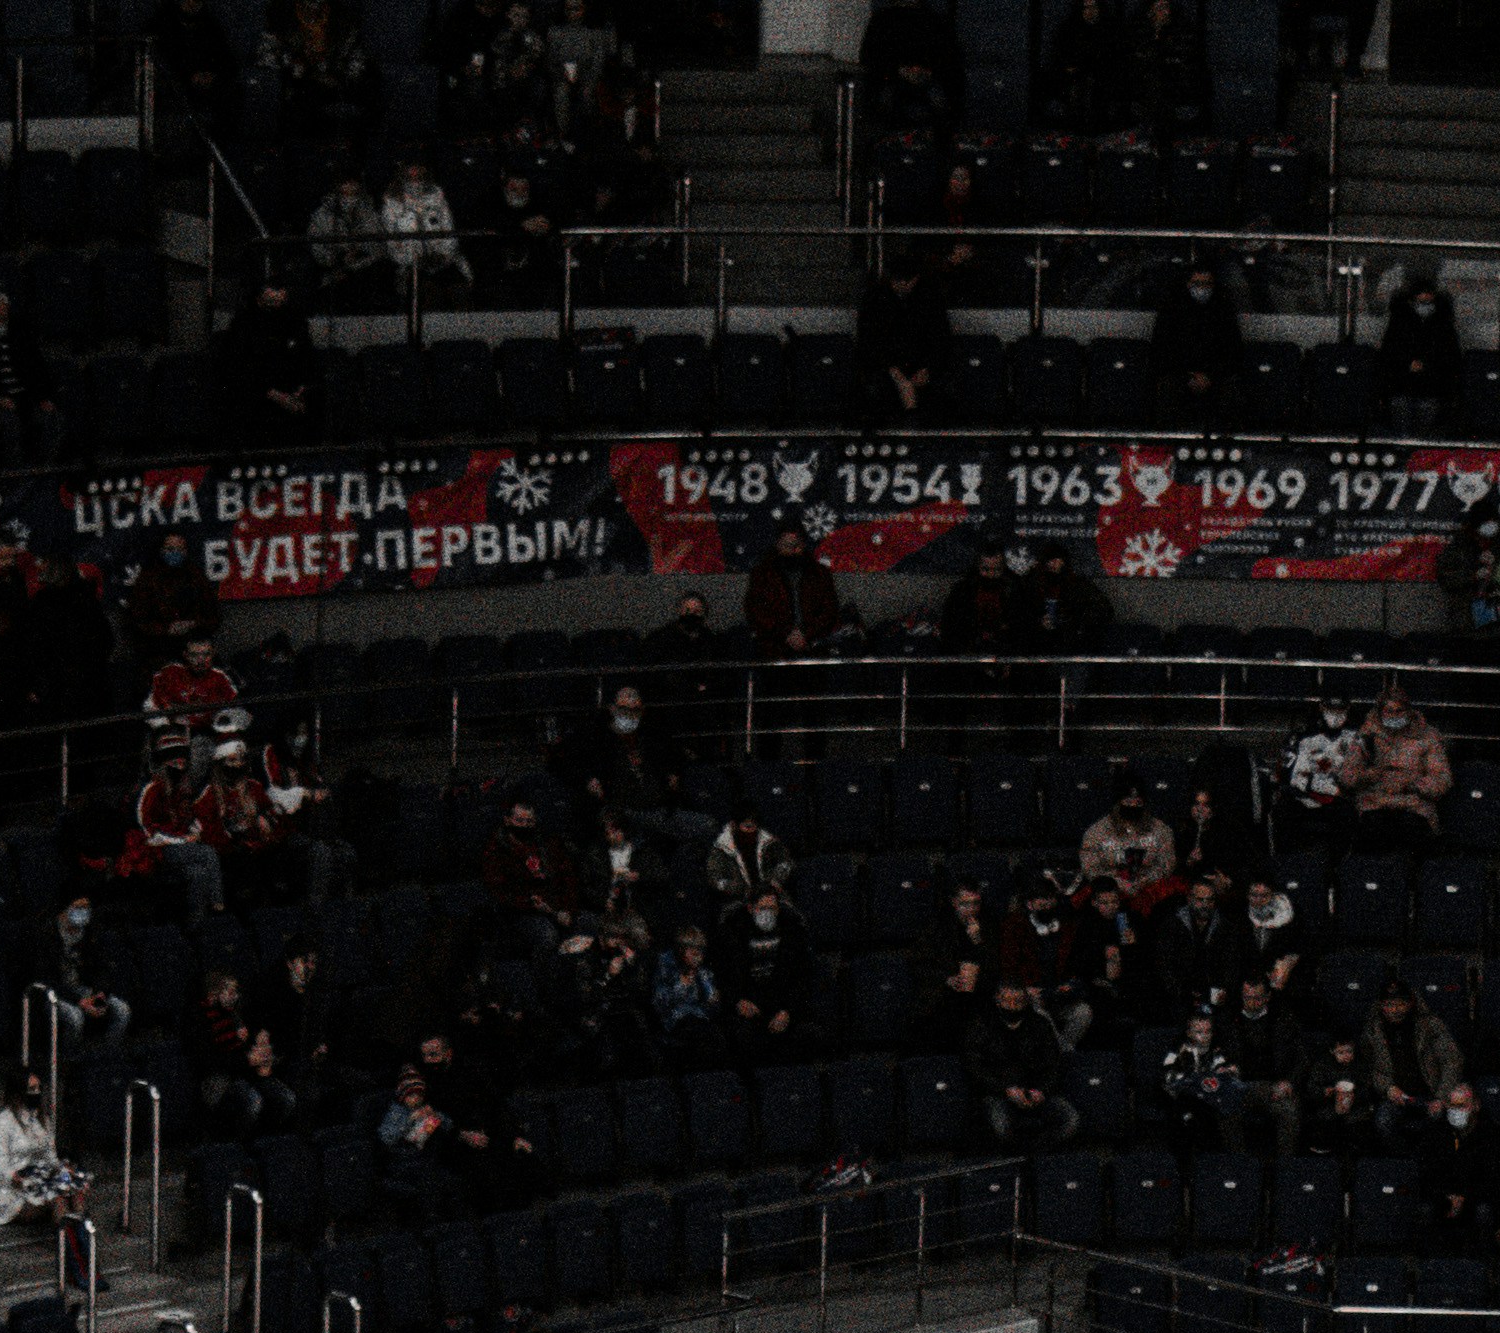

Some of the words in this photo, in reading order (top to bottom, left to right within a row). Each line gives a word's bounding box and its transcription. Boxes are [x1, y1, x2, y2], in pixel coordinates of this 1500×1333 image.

[74, 481, 201, 534] ЦСКА
[216, 471, 408, 523] ВСЕГДА
[657, 463, 769, 504] 1948
[837, 463, 951, 505] 1954
[1007, 464, 1122, 506] 1963
[1193, 467, 1306, 510] 1969
[1330, 469, 1439, 512] 1977
[204, 530, 360, 586] БУДЕТ
[376, 518, 606, 571] ПЕРВЫМ!
